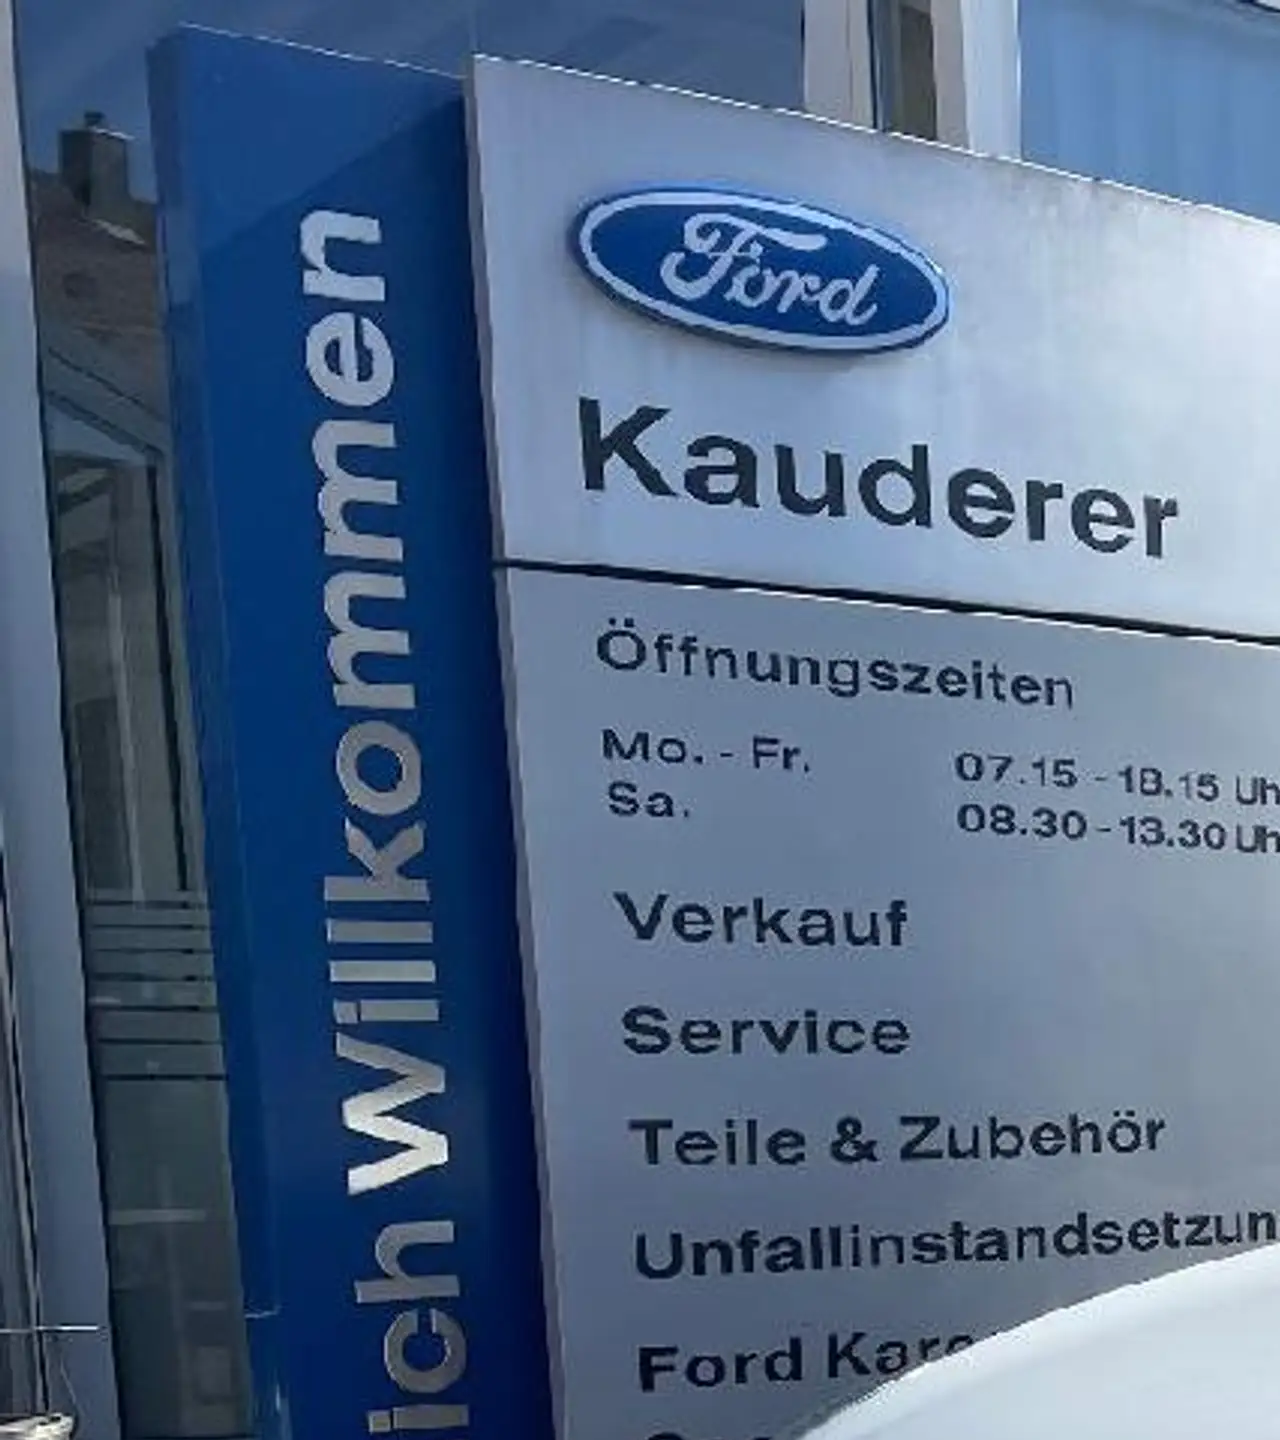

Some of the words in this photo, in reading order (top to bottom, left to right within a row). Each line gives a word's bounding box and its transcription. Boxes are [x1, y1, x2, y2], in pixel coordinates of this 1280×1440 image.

[660, 211, 879, 327] Ford
[577, 397, 1179, 559] Kauderer
[596, 617, 1076, 710] Öffnungszeiten
[299, 209, 448, 1195] Willkommen
[602, 728, 703, 764] Mo.
[752, 734, 812, 773] Fr.
[954, 751, 1079, 789] 07.15
[607, 780, 690, 818] Sa.
[613, 891, 909, 948] Verkauf
[620, 1005, 912, 1056] Service
[629, 1117, 807, 1166] Teile
[829, 1115, 879, 1165] &
[899, 1110, 1166, 1162] Zubehör
[637, 1337, 804, 1393] Ford
